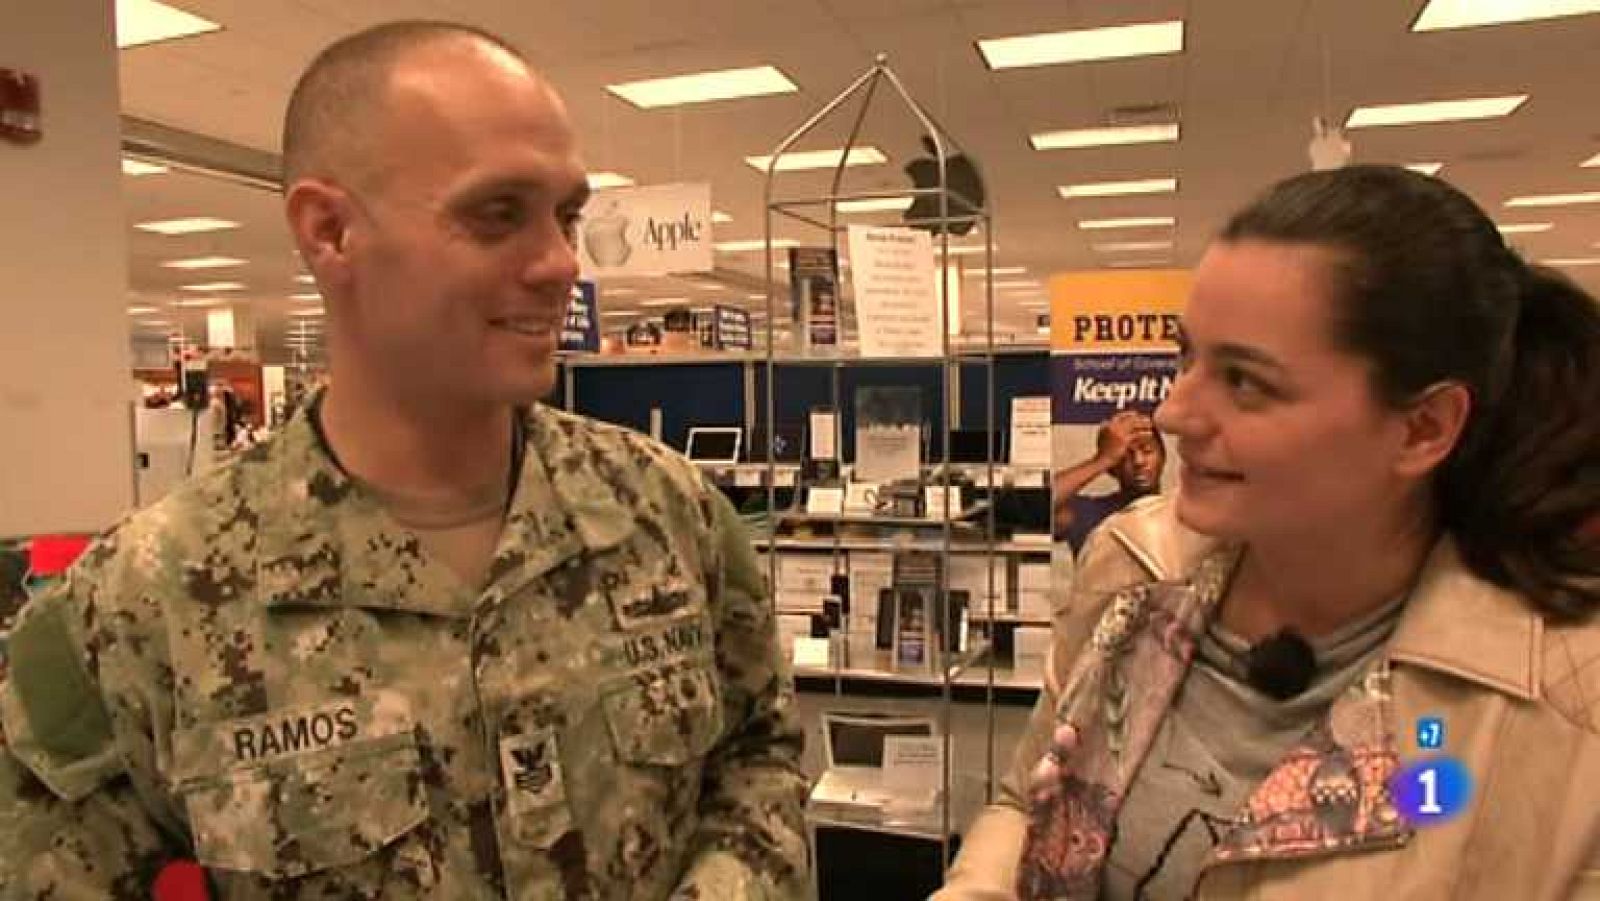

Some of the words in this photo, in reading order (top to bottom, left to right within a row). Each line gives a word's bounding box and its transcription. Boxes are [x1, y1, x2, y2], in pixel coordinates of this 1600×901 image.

[643, 211, 701, 251] Apple
[1073, 314, 1179, 342] PROTE
[1074, 376, 1137, 409] Keep
[234, 707, 358, 760] RAMOS
